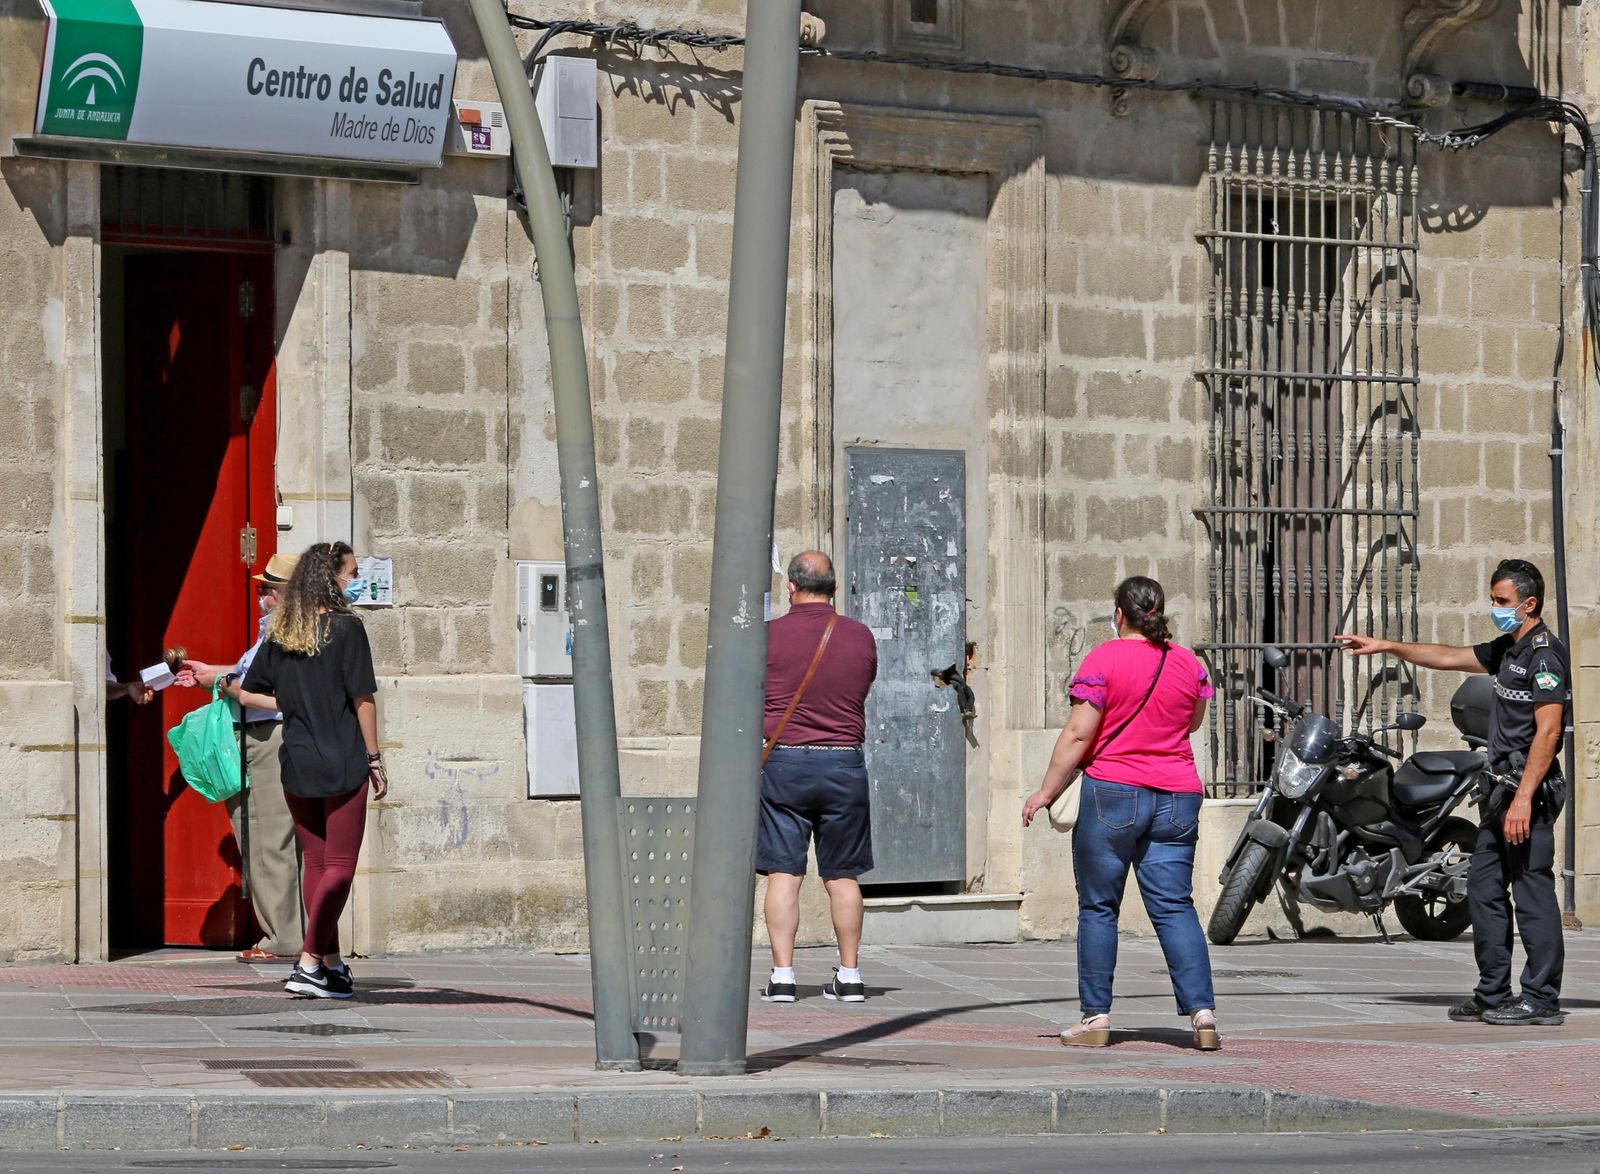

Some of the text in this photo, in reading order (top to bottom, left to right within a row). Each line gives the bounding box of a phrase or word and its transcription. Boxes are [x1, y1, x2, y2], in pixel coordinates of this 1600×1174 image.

[246, 57, 445, 110] Centro de Salud
[54, 108, 75, 120] JUNTA
[77, 109, 86, 121] DE
[330, 111, 436, 145] Madre de Dios
